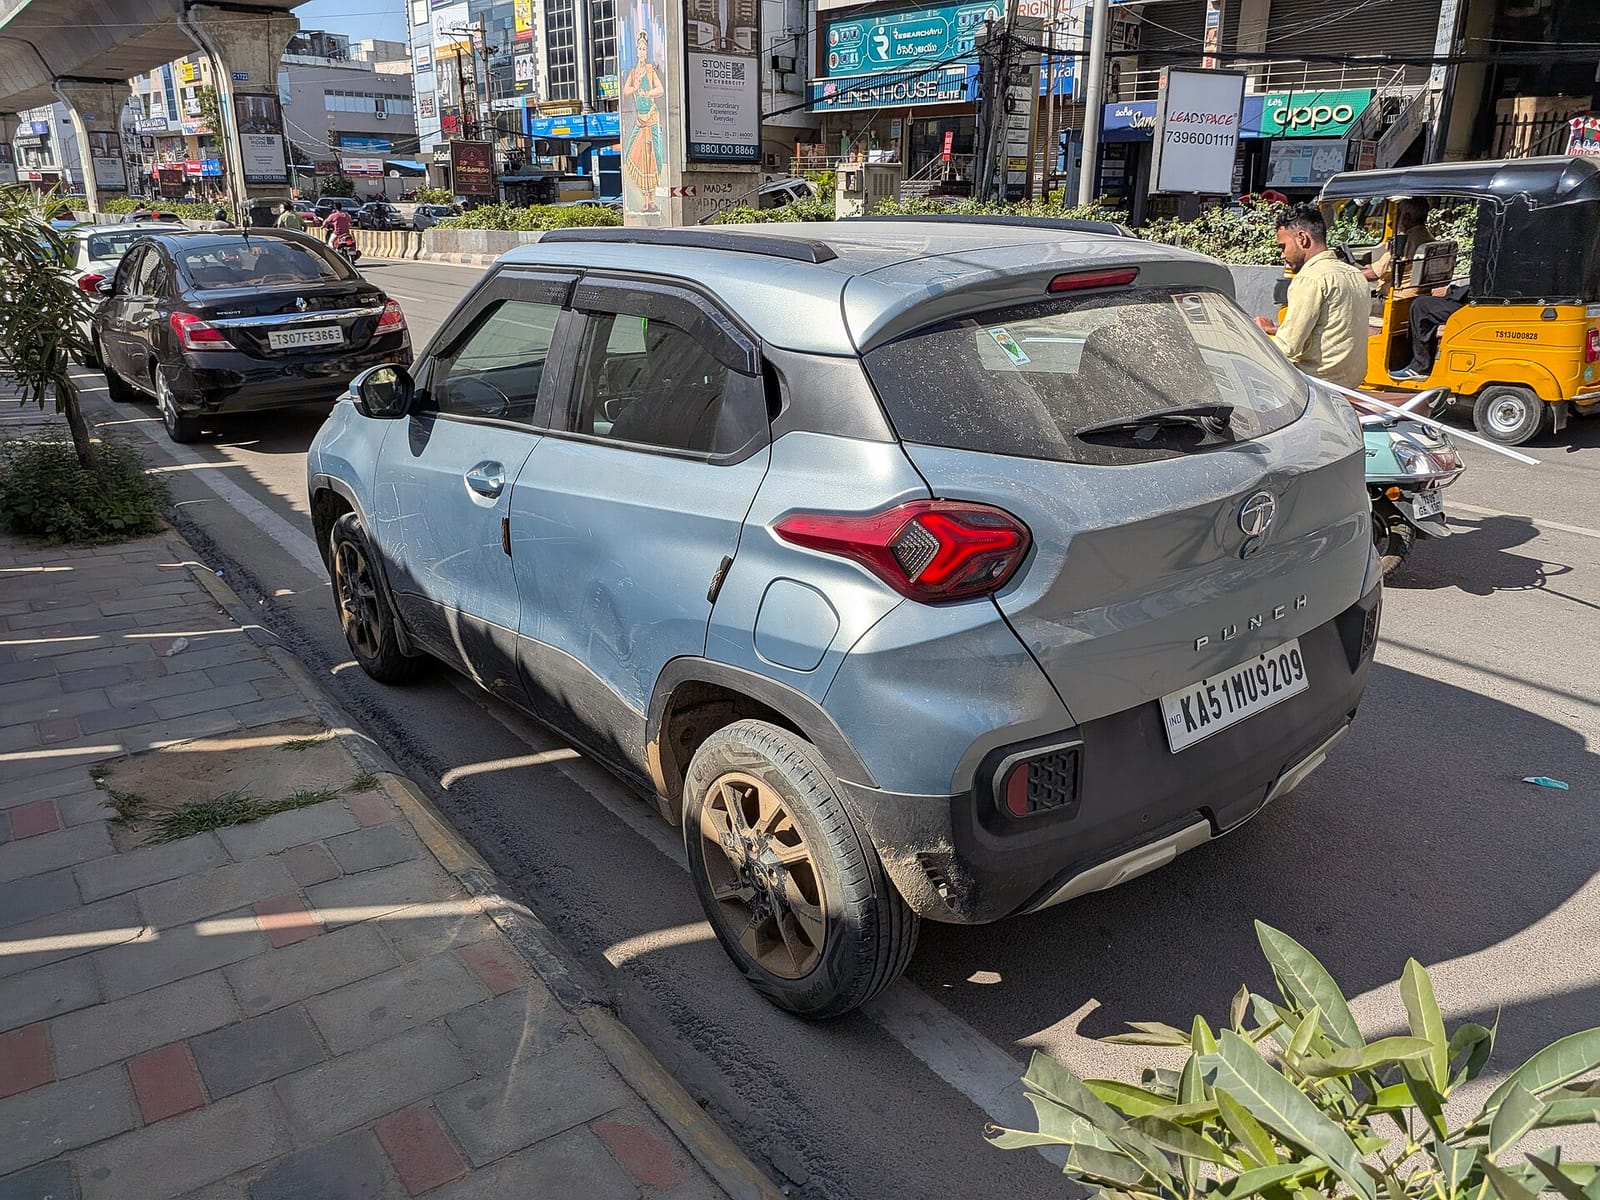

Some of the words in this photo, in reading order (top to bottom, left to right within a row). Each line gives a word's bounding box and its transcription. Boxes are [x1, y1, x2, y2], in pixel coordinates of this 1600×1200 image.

[702, 60, 732, 70] STONE
[705, 69, 732, 79] RIDGE
[838, 88, 880, 104] LINEN
[883, 80, 938, 101] HOUSE
[937, 90, 960, 100] ELITE
[707, 101, 740, 110] Extraordinary
[710, 108, 738, 116] Experiences
[1273, 104, 1354, 130] oppo
[713, 115, 735, 123] Everyday
[1169, 112, 1235, 126] LEADSPACE
[1166, 131, 1235, 147] 7396001111
[700, 144, 719, 154] 8801
[720, 145, 734, 154] 00
[735, 145, 755, 155] 8866
[276, 329, 341, 345] TS07FE3863
[1495, 330, 1538, 340] TS13UD0828
[1194, 594, 1307, 652] PUNCH
[1168, 713, 1182, 728] IND
[1180, 648, 1304, 733] KA51MU9209
